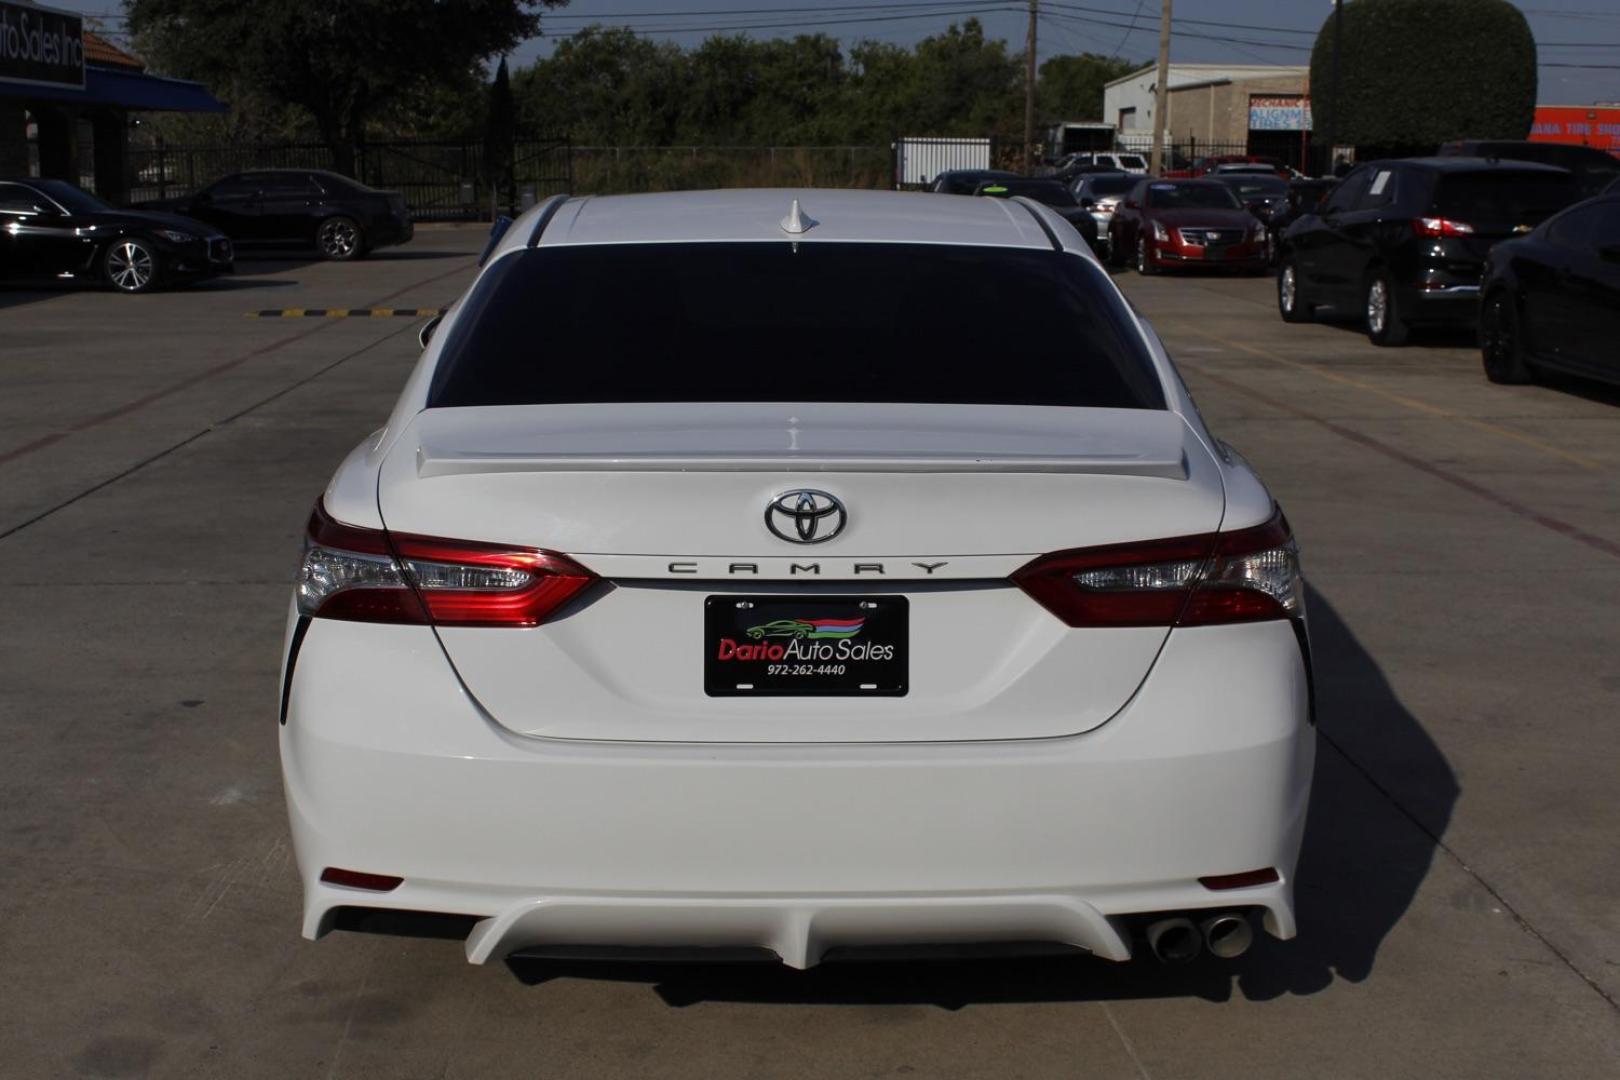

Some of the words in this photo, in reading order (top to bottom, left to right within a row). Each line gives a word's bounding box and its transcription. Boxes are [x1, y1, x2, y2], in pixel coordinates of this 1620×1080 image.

[668, 562, 949, 575] CAMRY
[718, 639, 784, 660] Dario
[783, 638, 833, 660] Auto
[835, 638, 894, 660] Sales
[767, 664, 845, 676] 972-262-4440
